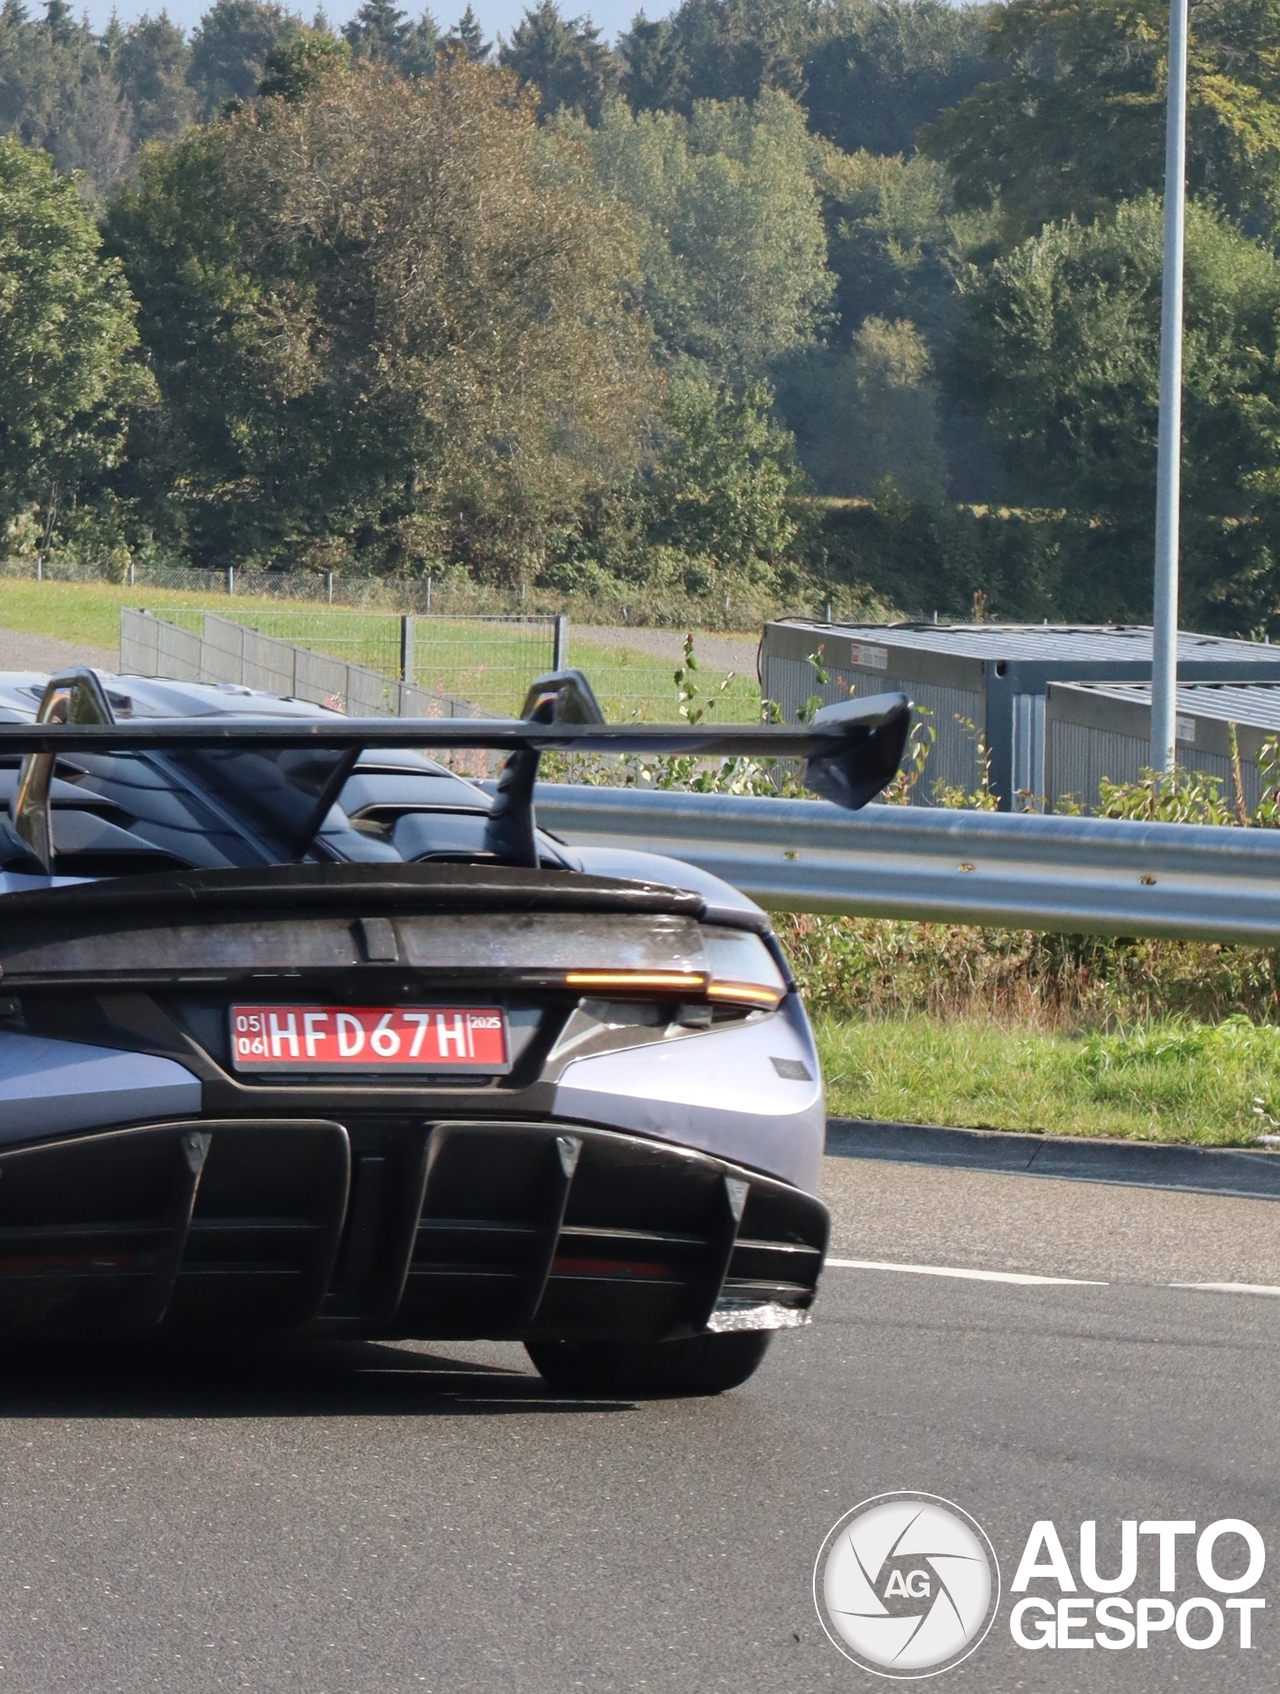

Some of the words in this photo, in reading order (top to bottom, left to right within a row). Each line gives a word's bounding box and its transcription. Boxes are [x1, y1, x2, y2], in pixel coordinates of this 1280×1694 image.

[236, 1015, 261, 1032] 05
[470, 1016, 501, 1029] 2025
[269, 1012, 466, 1058] HFD67H
[238, 1037, 264, 1055] 06
